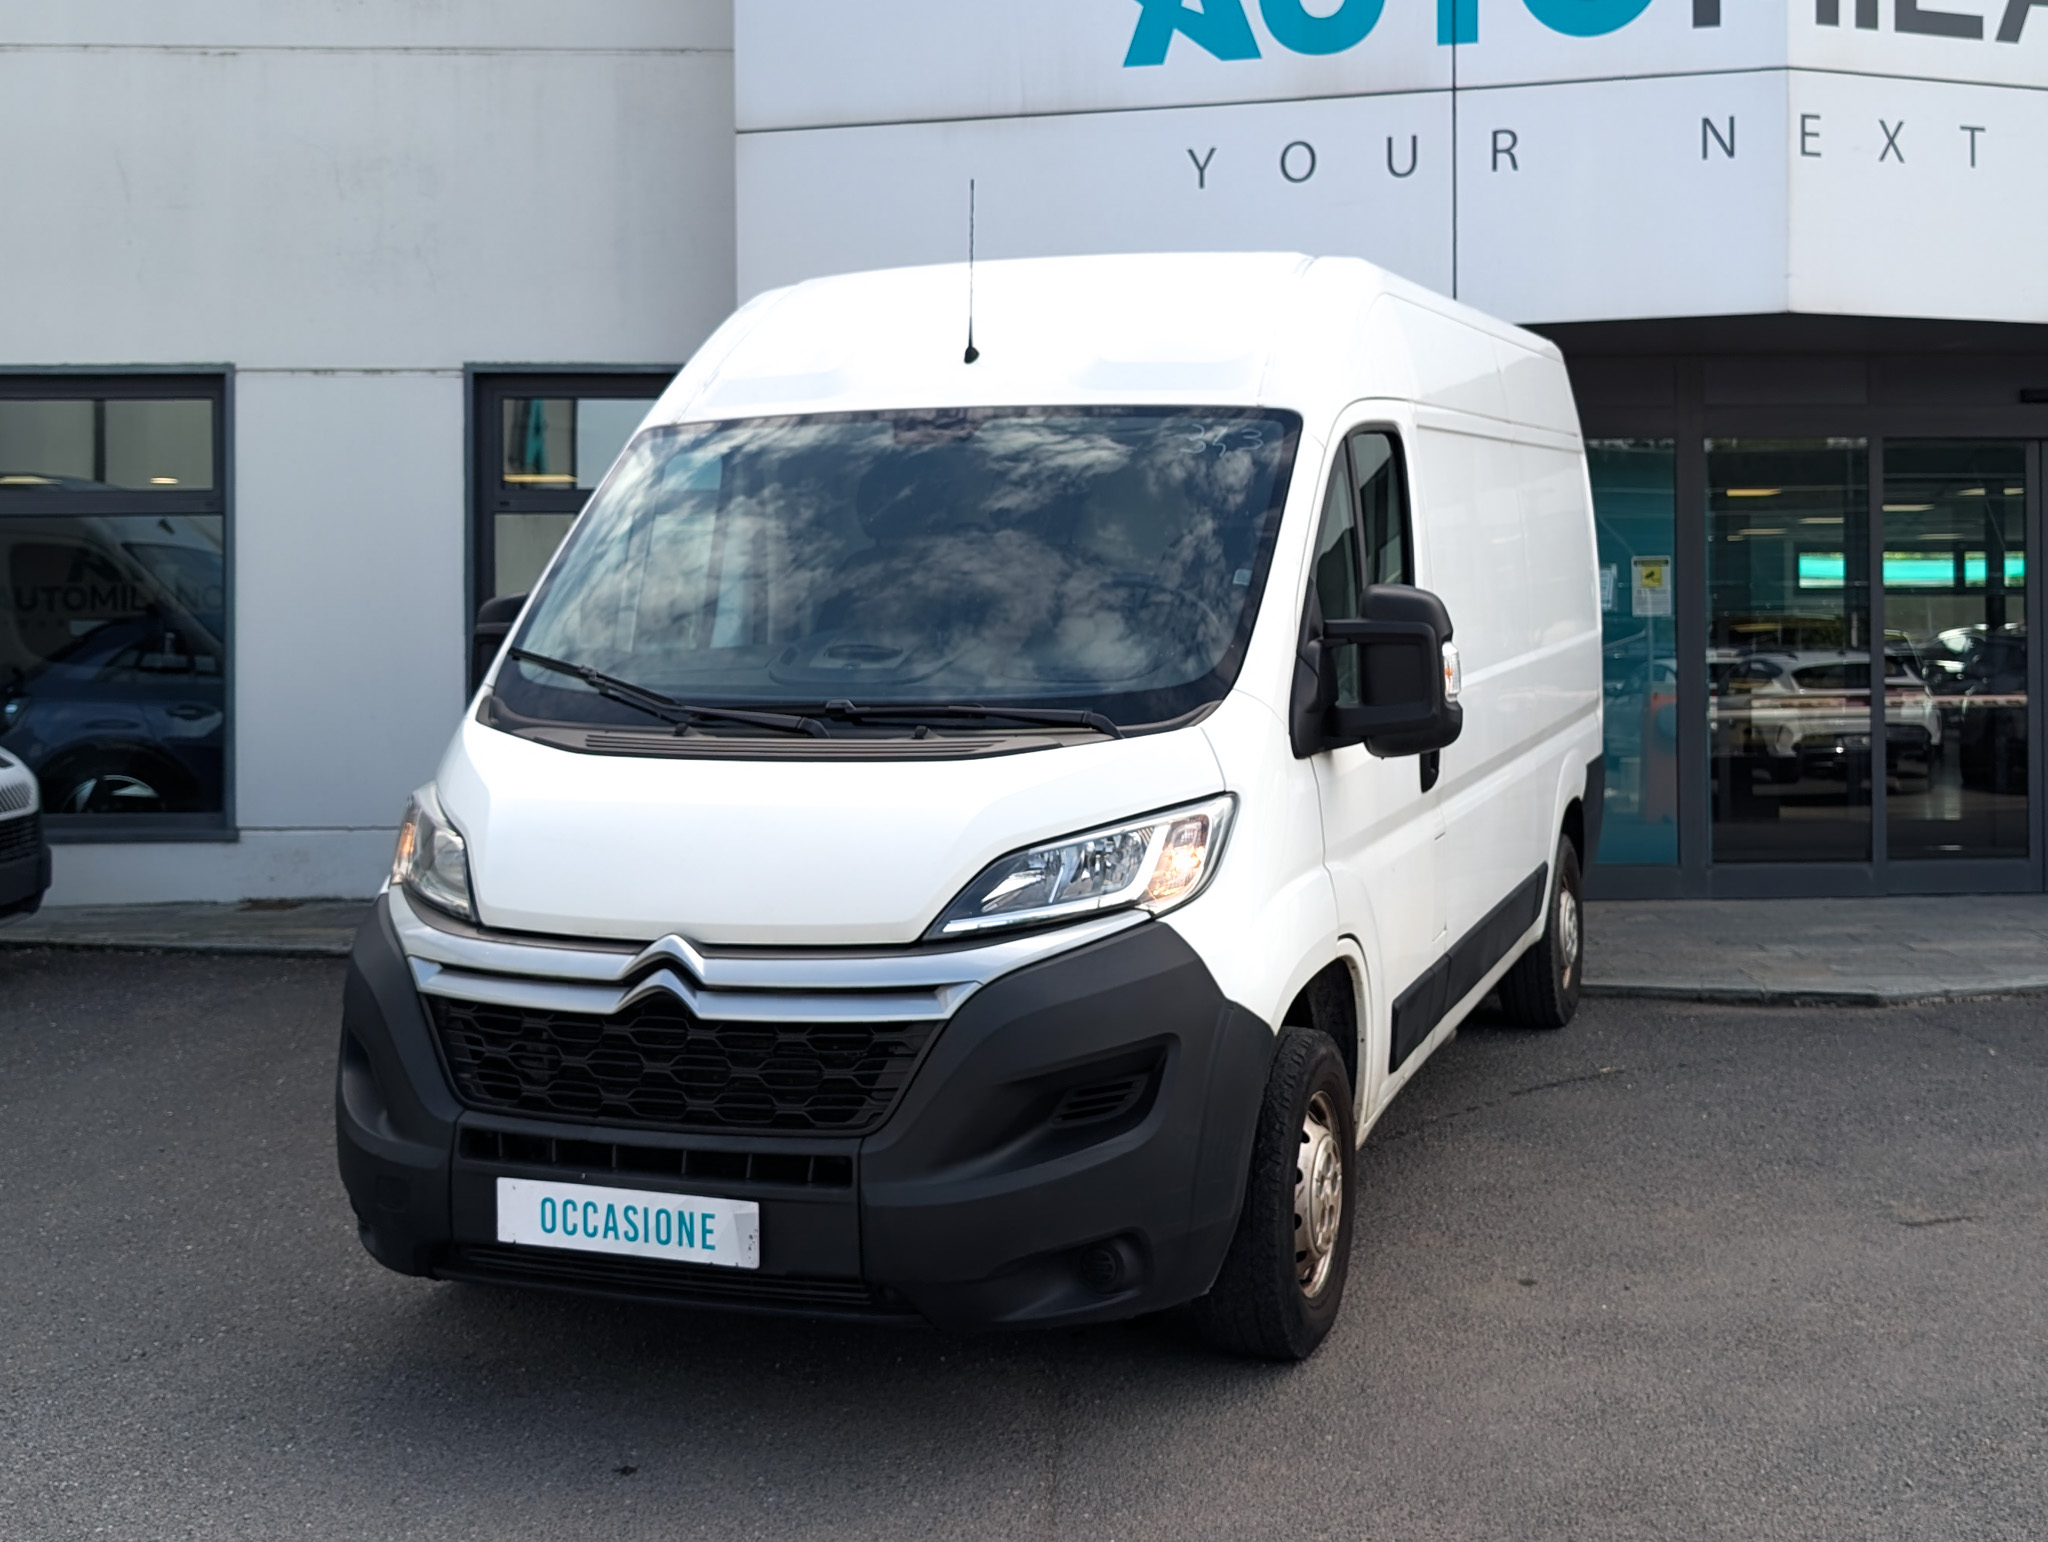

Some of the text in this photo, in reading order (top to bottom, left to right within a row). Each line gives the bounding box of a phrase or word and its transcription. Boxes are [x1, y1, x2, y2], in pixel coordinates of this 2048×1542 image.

[1187, 114, 1987, 190] YOUR NEXT
[540, 1196, 716, 1251] OCCASIONE
